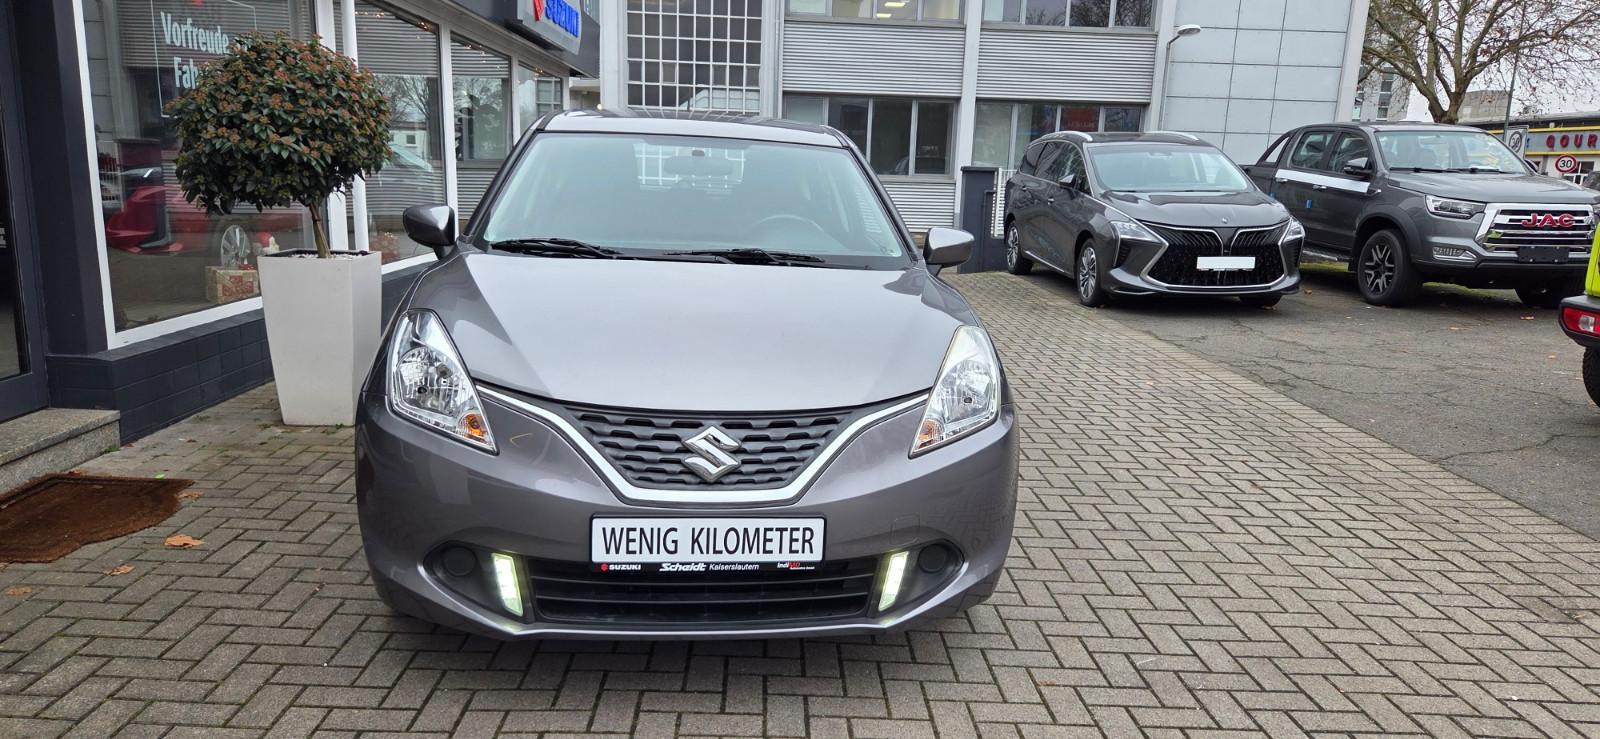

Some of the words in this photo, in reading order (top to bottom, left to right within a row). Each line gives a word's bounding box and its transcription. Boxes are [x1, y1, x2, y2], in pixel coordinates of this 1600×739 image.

[160, 11, 230, 55] Vorfreude
[1559, 159, 1573, 168] 30
[1521, 213, 1576, 228] JAC
[602, 526, 679, 555] WENIG
[690, 526, 814, 555] KILOMETER
[708, 562, 760, 571] Kaiserslautern
